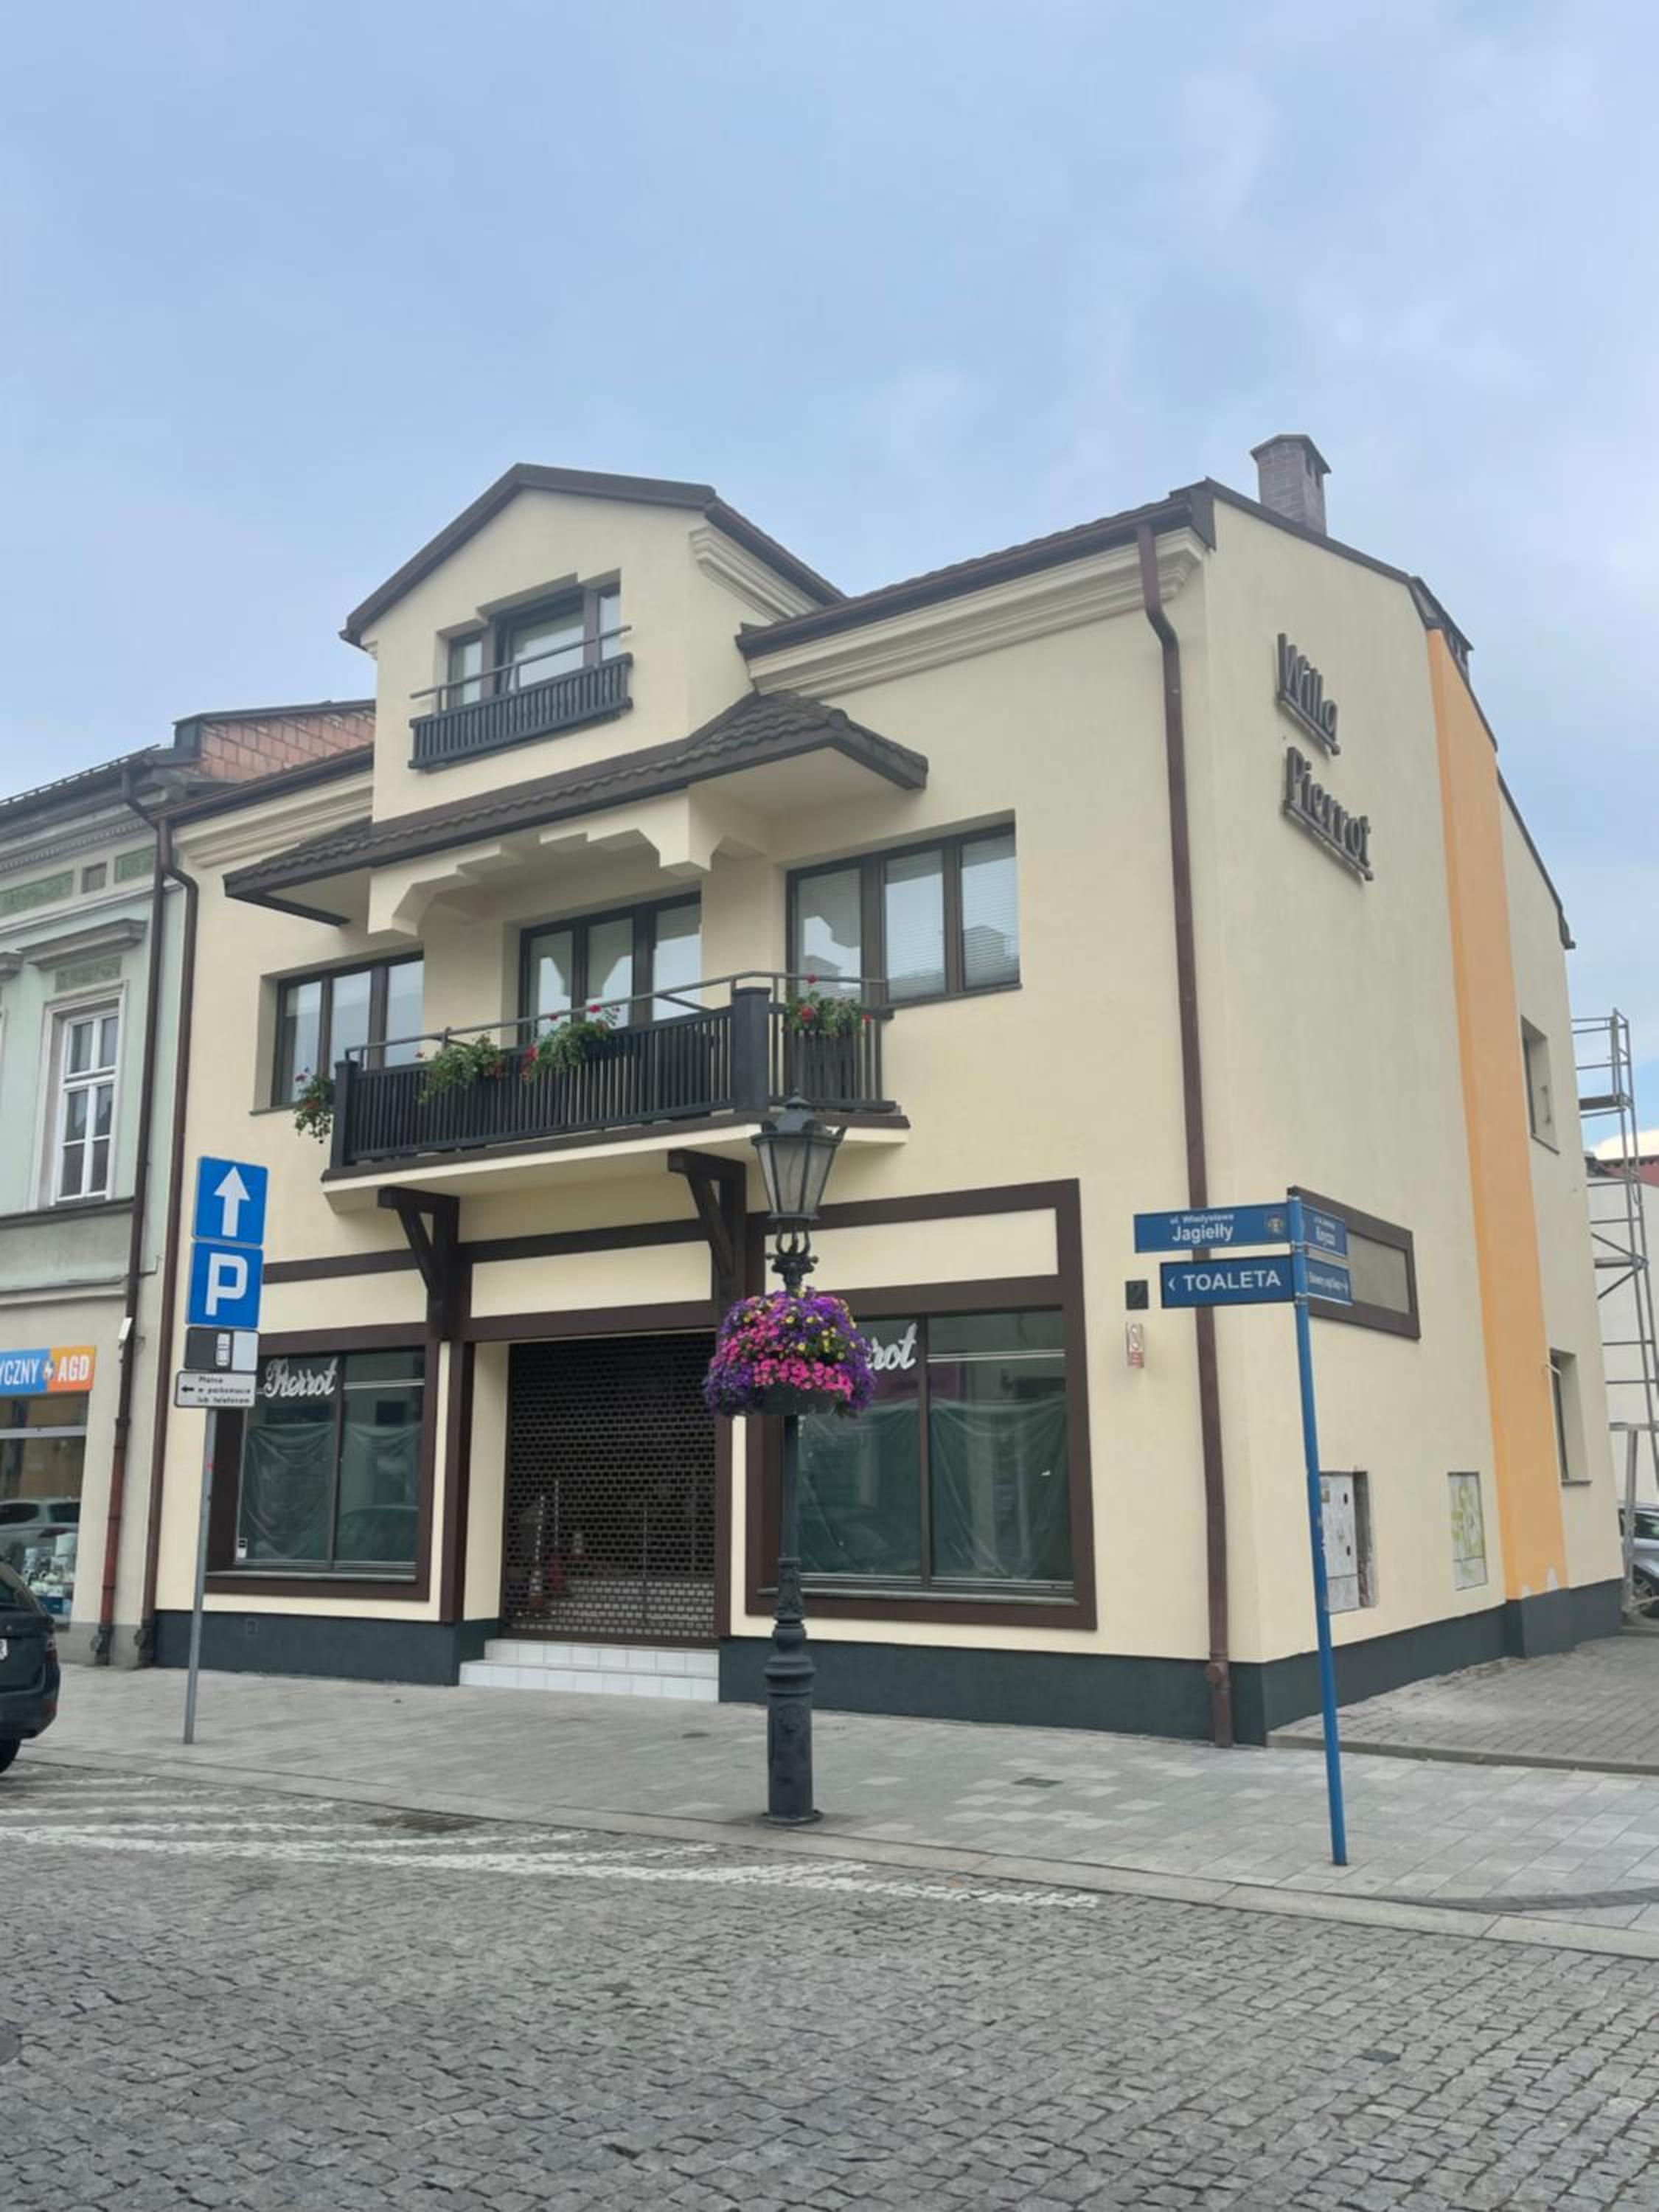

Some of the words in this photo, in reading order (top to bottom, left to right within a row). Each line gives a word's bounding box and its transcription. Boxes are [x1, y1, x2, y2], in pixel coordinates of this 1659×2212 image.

[1287, 745, 1371, 870] Pierrot
[205, 1252, 248, 1317] P
[1183, 1270, 1281, 1291] TOALETA
[58, 1354, 90, 1382] AGD
[264, 1357, 338, 1398] Pierrot
